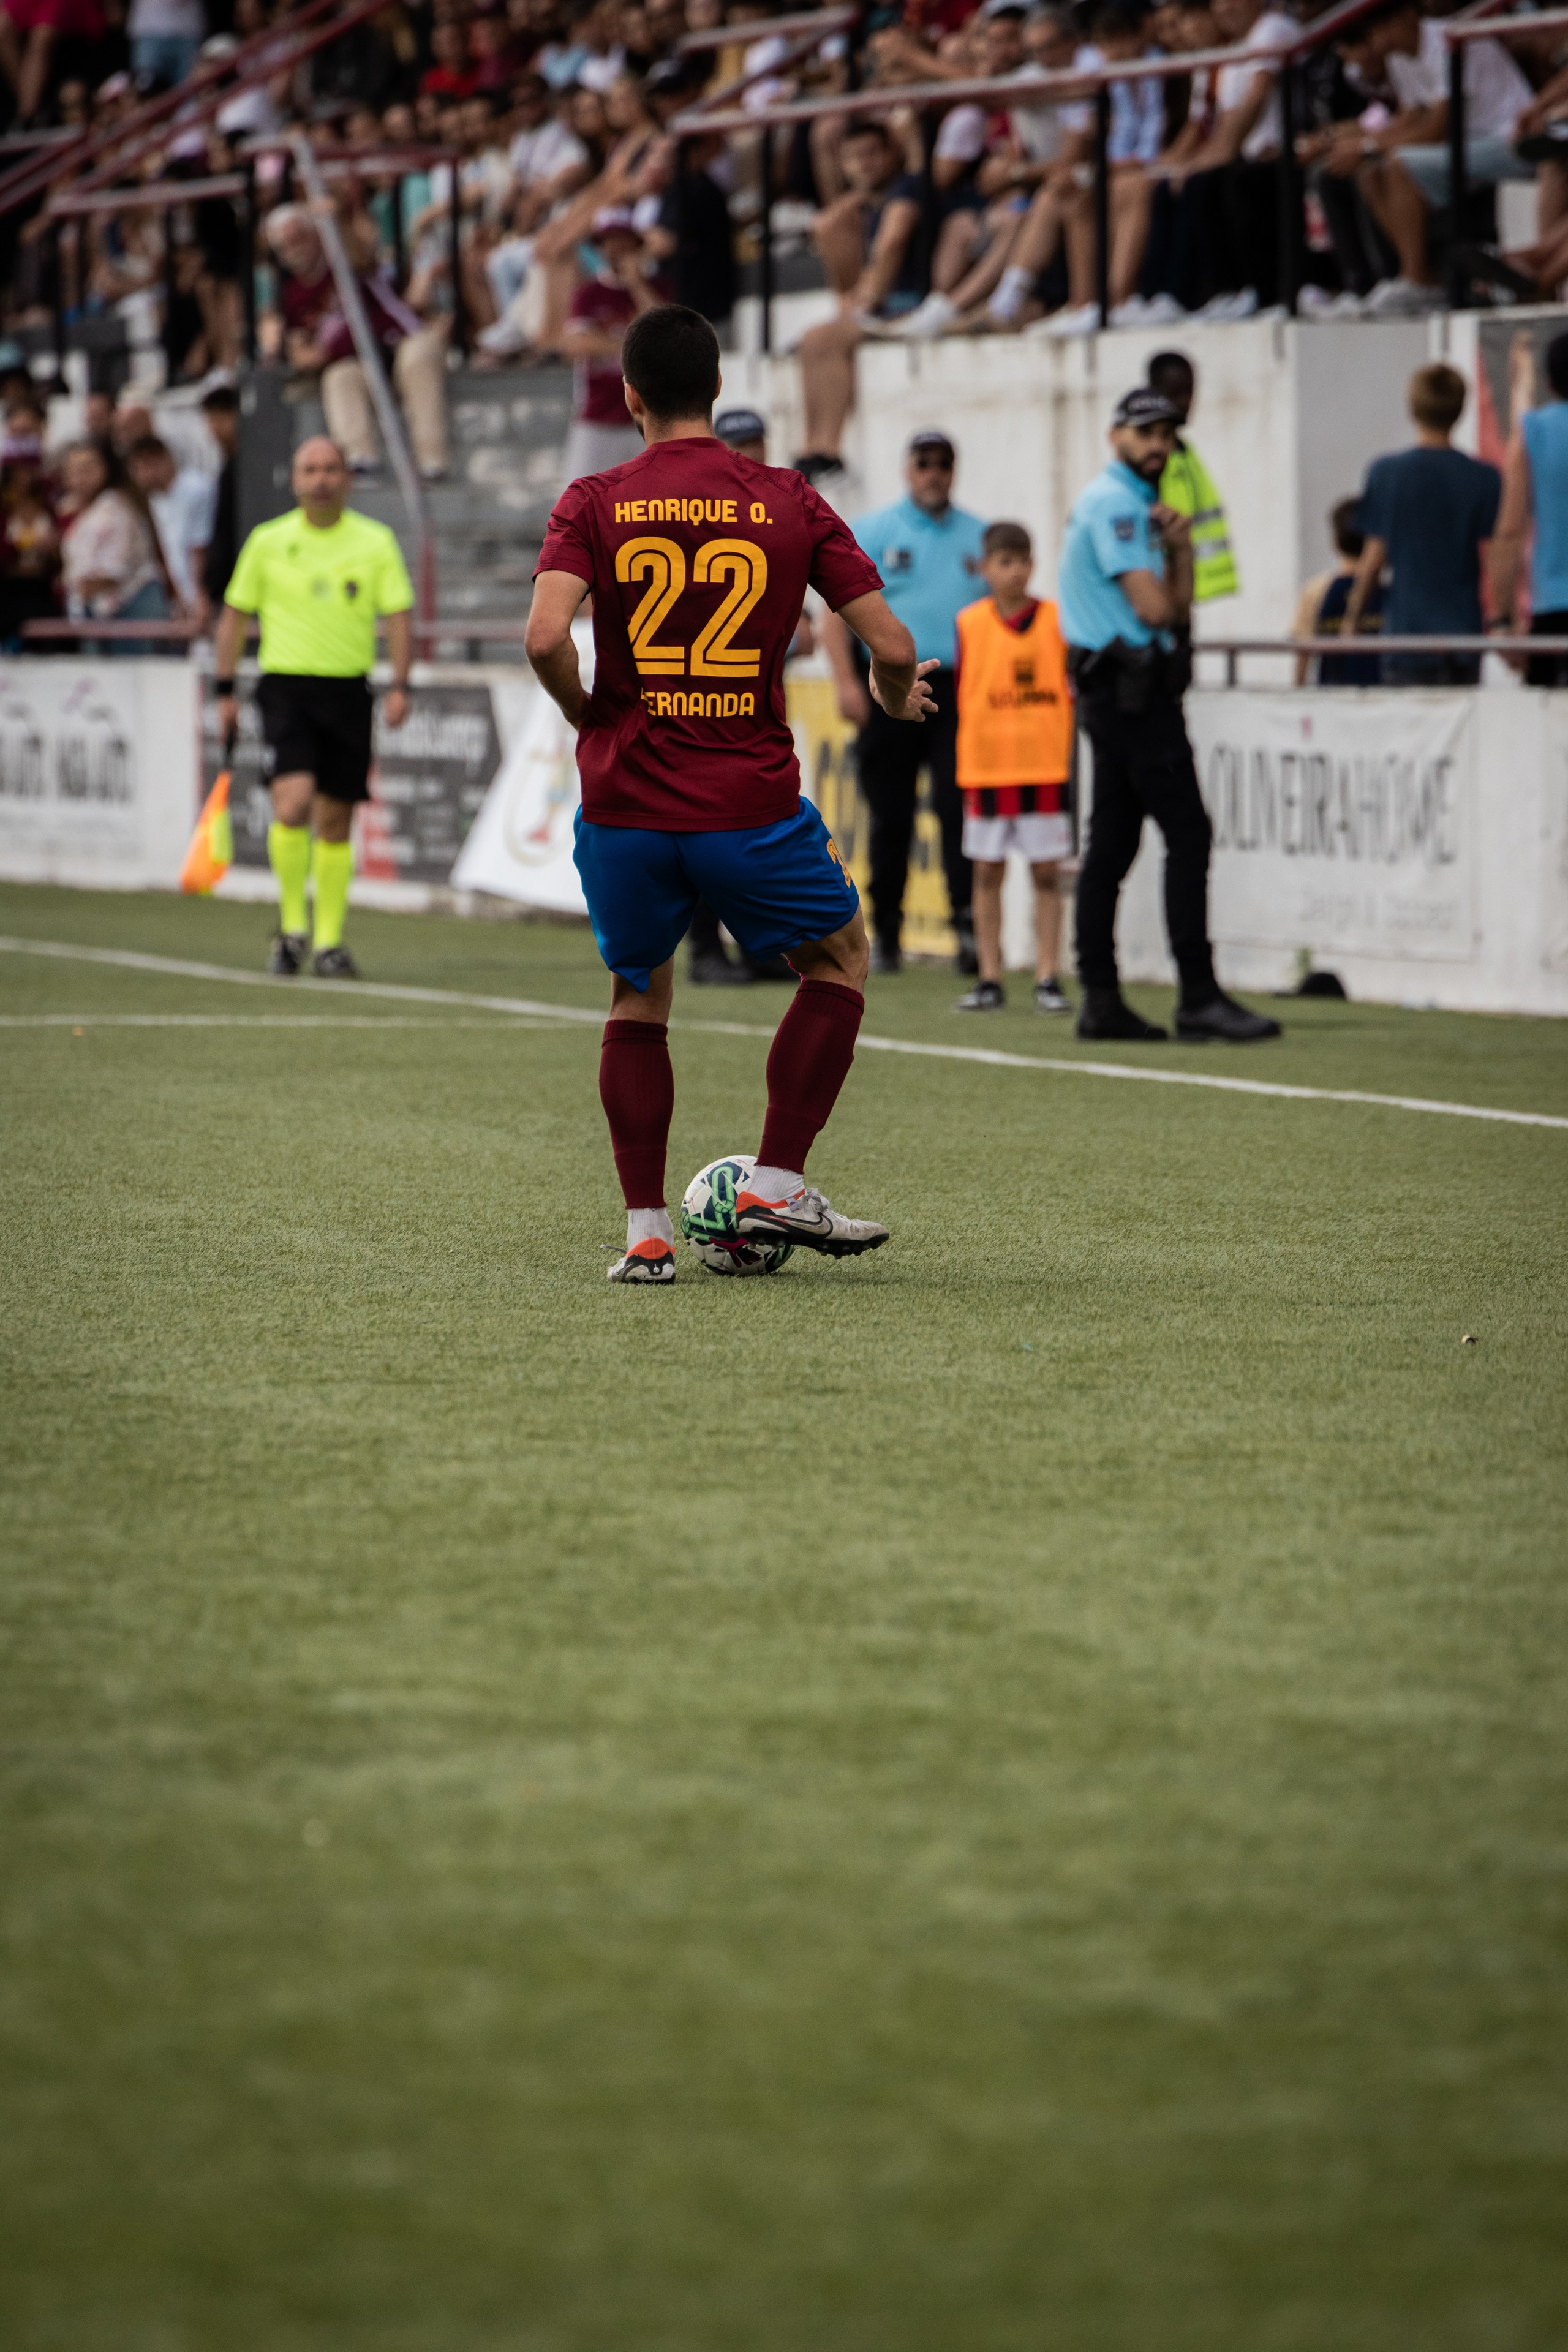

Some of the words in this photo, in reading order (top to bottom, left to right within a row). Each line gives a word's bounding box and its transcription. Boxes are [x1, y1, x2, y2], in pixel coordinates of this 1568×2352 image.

[614, 498, 738, 526] HENRIQUE
[750, 502, 773, 524] O.
[614, 536, 768, 677] 22
[641, 687, 755, 717] ERNANDA
